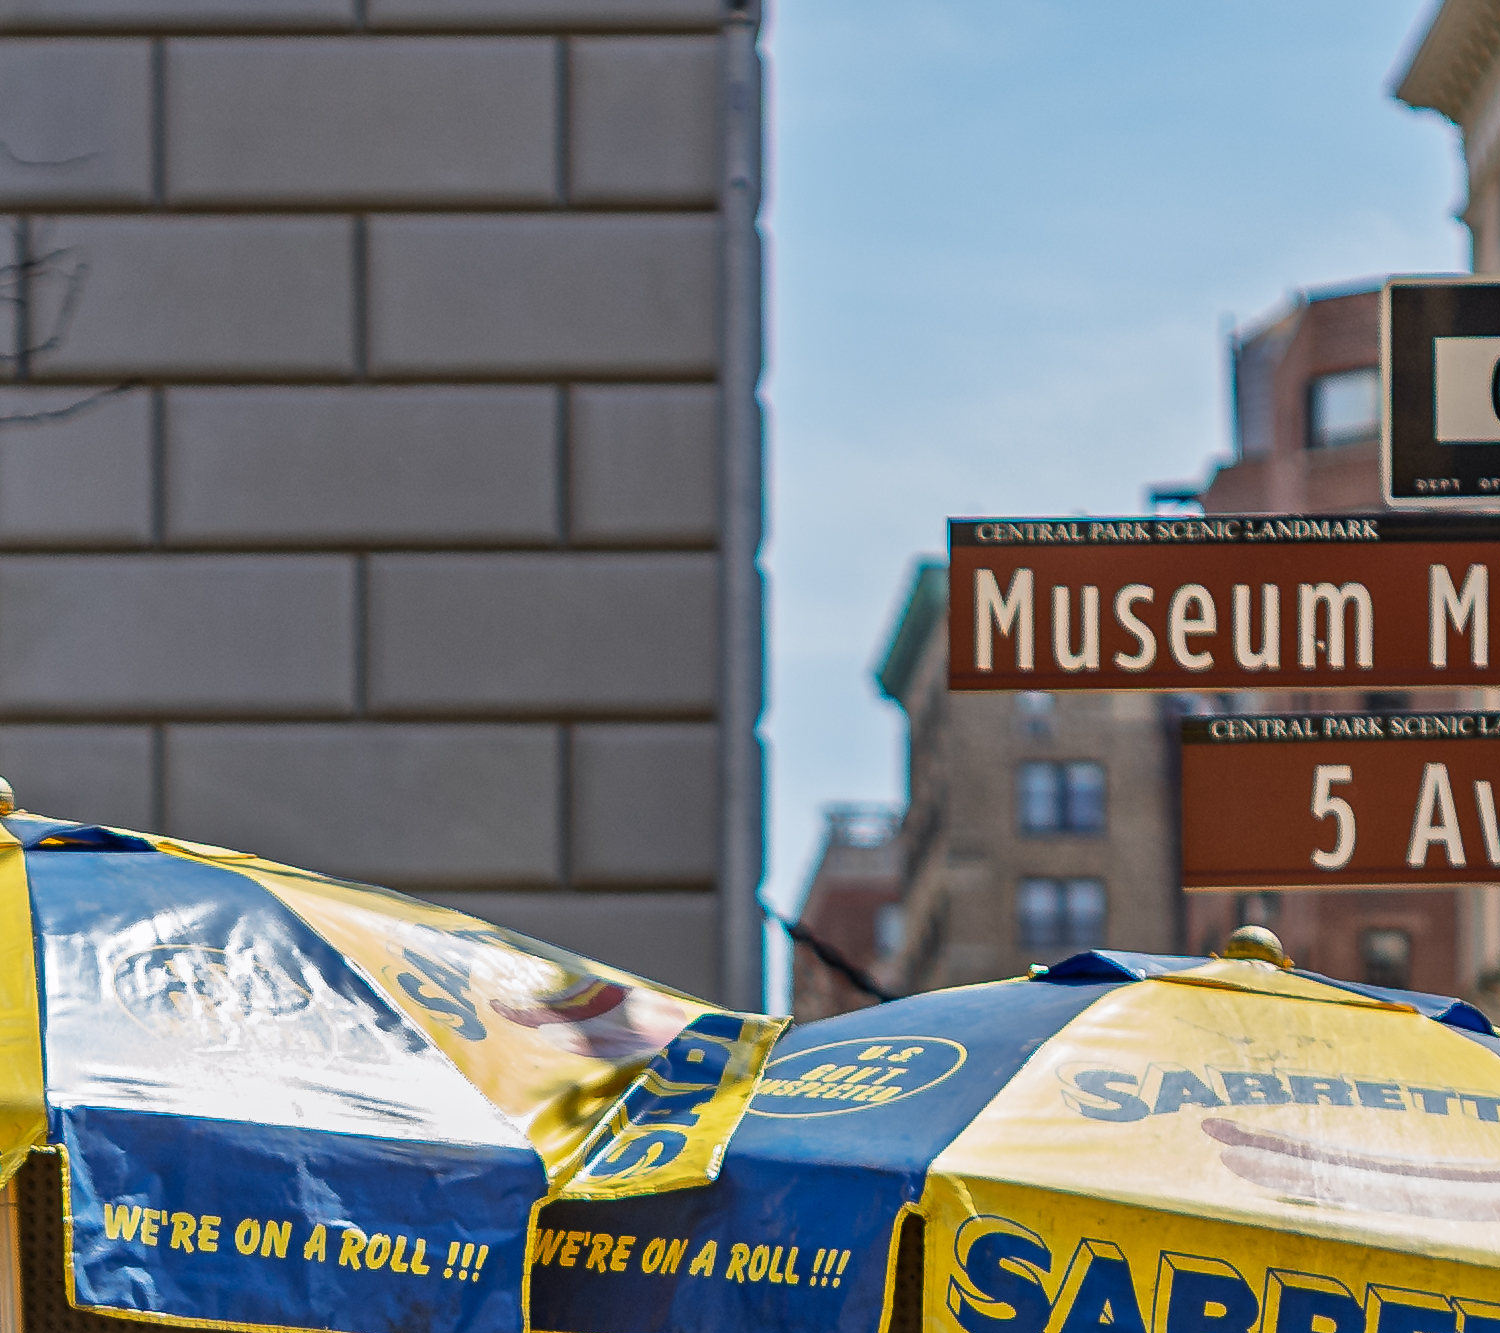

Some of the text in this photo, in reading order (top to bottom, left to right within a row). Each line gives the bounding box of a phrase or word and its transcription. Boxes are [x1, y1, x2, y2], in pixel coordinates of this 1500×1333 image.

[1415, 477, 1461, 492] DEPT
[975, 518, 1380, 543] CENTRAL PARK SCENIC LANDMARK
[973, 566, 1374, 672] Museum
[1210, 717, 1318, 741] CENTRAL
[1322, 716, 1386, 739] PARK
[1390, 716, 1477, 738] SCENIC
[1311, 763, 1356, 871] 5
[103, 1203, 430, 1276] WE'RE ON A ROLL
[534, 1227, 801, 1286] WE'RE ON A ROLL
